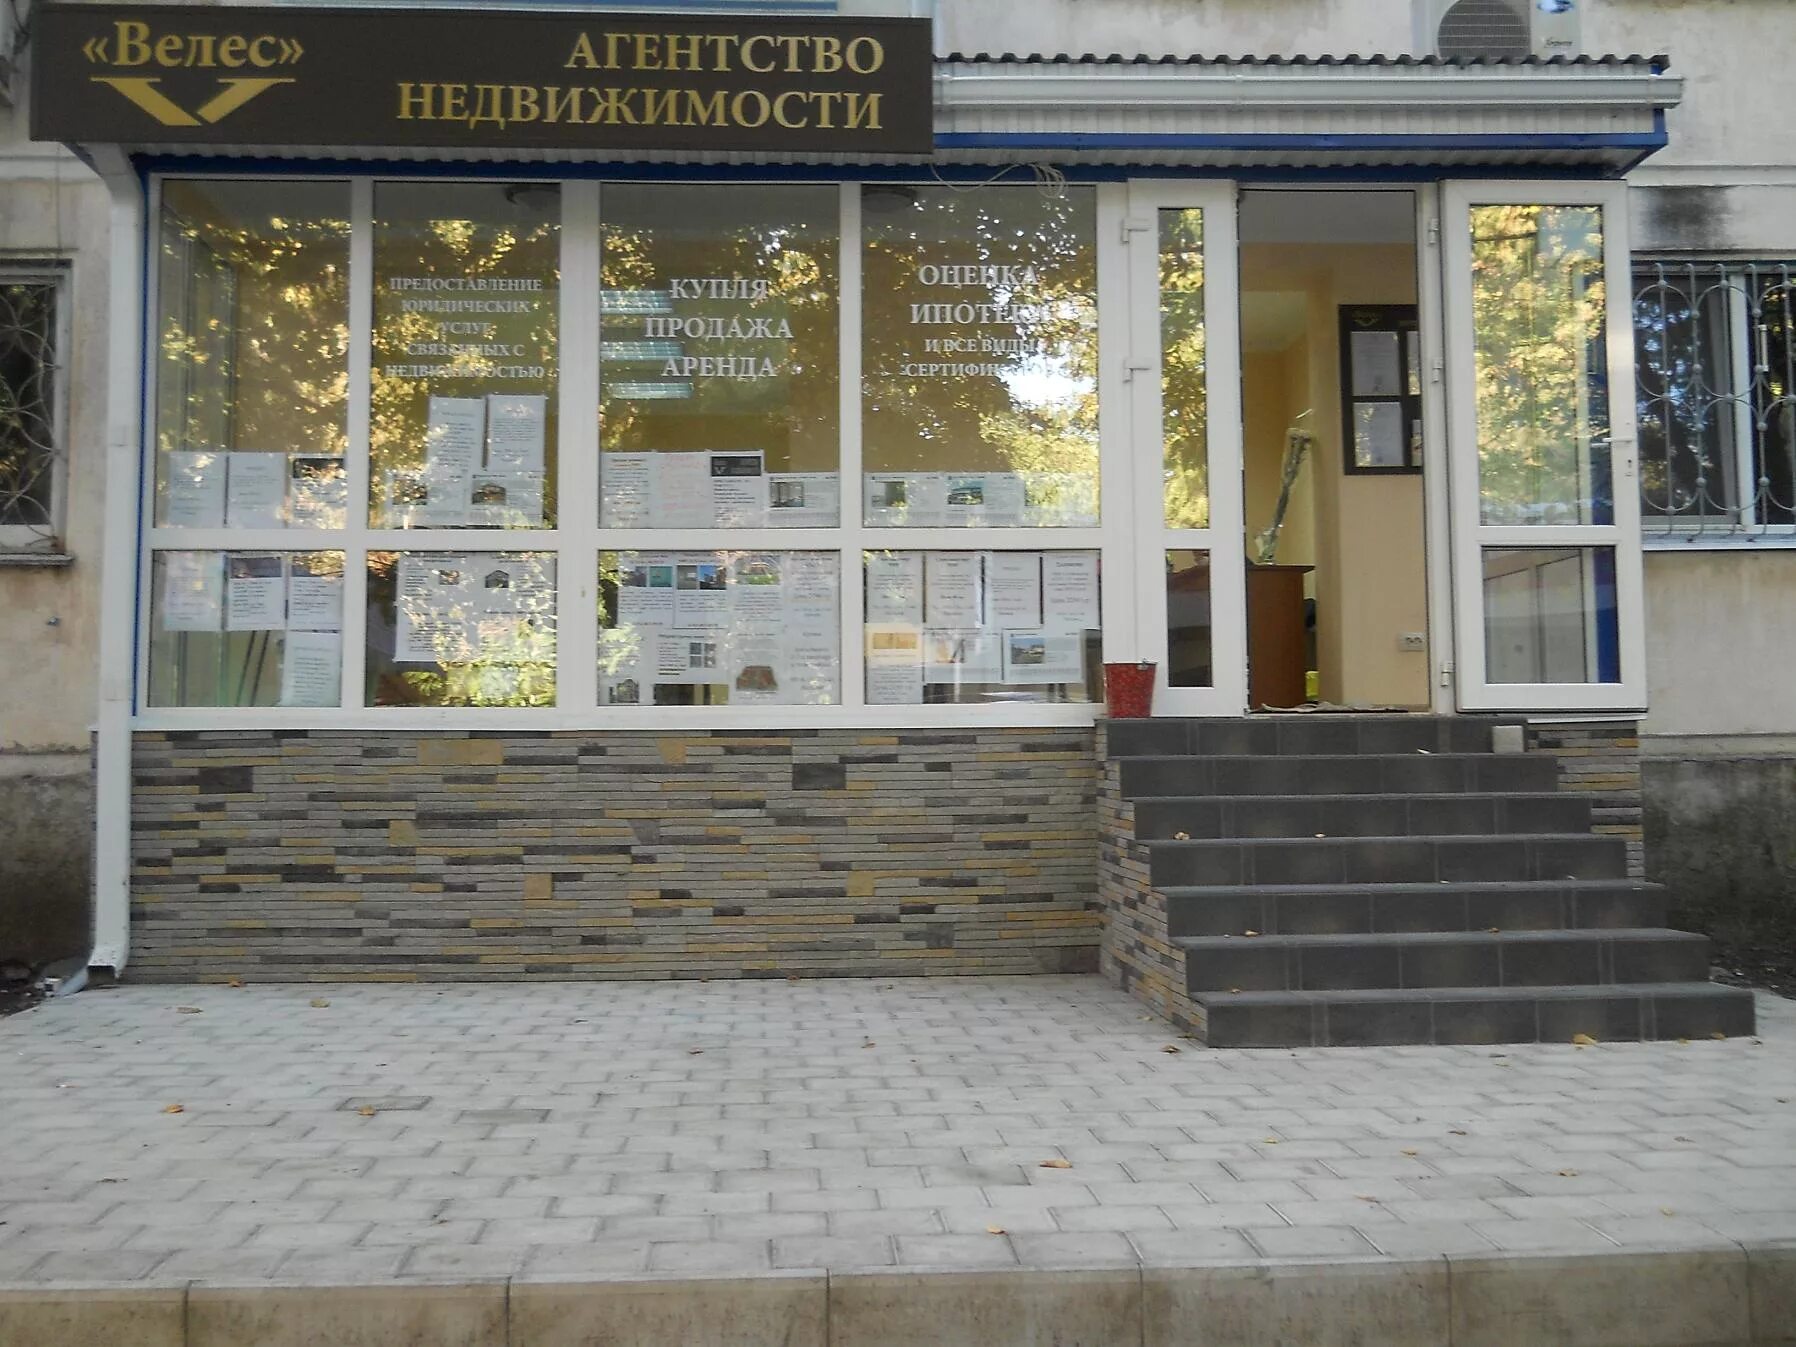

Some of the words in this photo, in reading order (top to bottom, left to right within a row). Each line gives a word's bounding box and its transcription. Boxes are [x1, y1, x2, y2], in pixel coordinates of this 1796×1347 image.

[82, 21, 304, 67] «Велес»
[564, 32, 885, 73] АГЕНТСТВО
[396, 82, 884, 130] НЕДВИЖИМОСТИ
[389, 277, 543, 292] ПРЕДОСТАВЛЕНИЕ
[918, 264, 1039, 289] ОЦЕНКА
[669, 278, 768, 299] КУПЛЯ
[402, 299, 531, 313] ЮРИДИЧЕСКИХ
[644, 317, 794, 343] ПРОДАЖА
[408, 343, 511, 357] СВЯЗНЫХ
[513, 343, 526, 357] С
[943, 338, 977, 353] ВСЕ
[384, 364, 545, 379] НЕДВИОСТЬЮ
[661, 356, 777, 381] АРЕНДА
